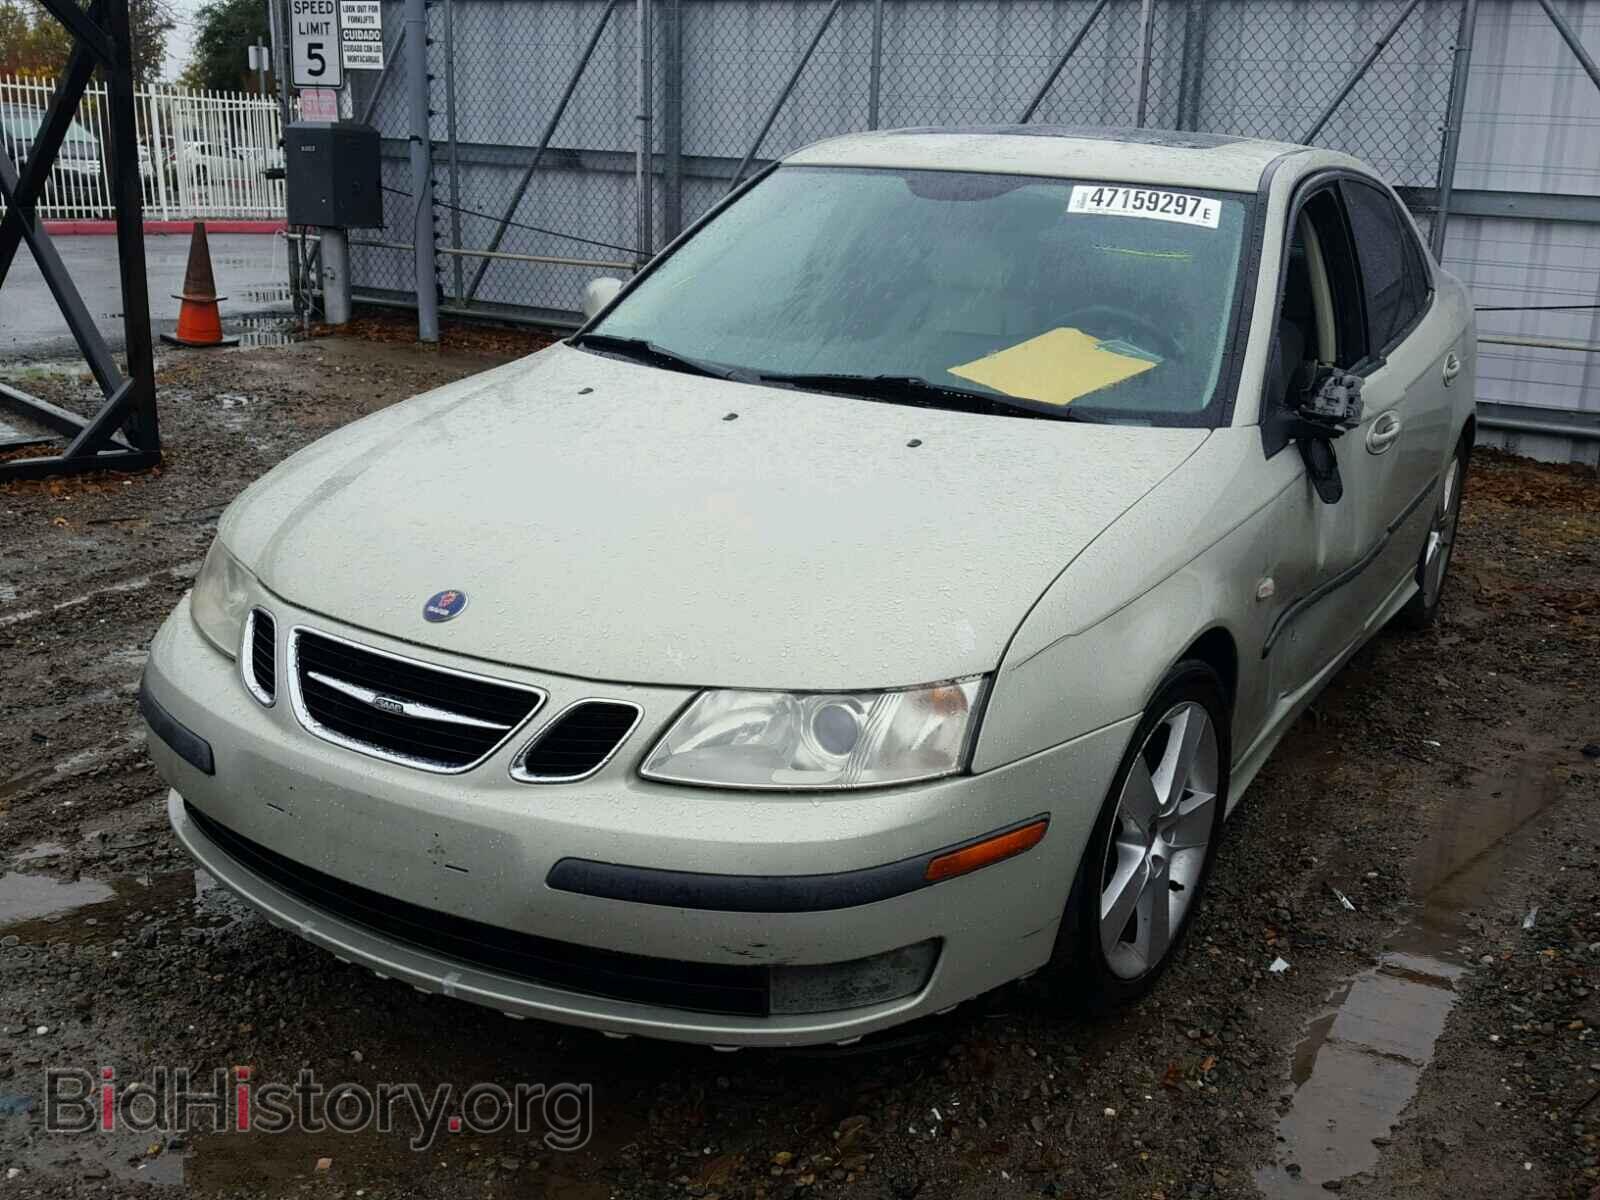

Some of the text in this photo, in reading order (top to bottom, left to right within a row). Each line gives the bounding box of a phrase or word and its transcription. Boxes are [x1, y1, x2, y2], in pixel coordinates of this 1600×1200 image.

[294, 0, 334, 14] SPEED
[343, 5, 378, 13] LOOK OUT FOR
[348, 16, 375, 24] FORKLIFTS
[299, 22, 331, 35] LIMIT
[343, 30, 381, 40] CUIDADO
[307, 42, 326, 77] 5
[1090, 188, 1203, 217] 47159297
[1203, 207, 1212, 221] E
